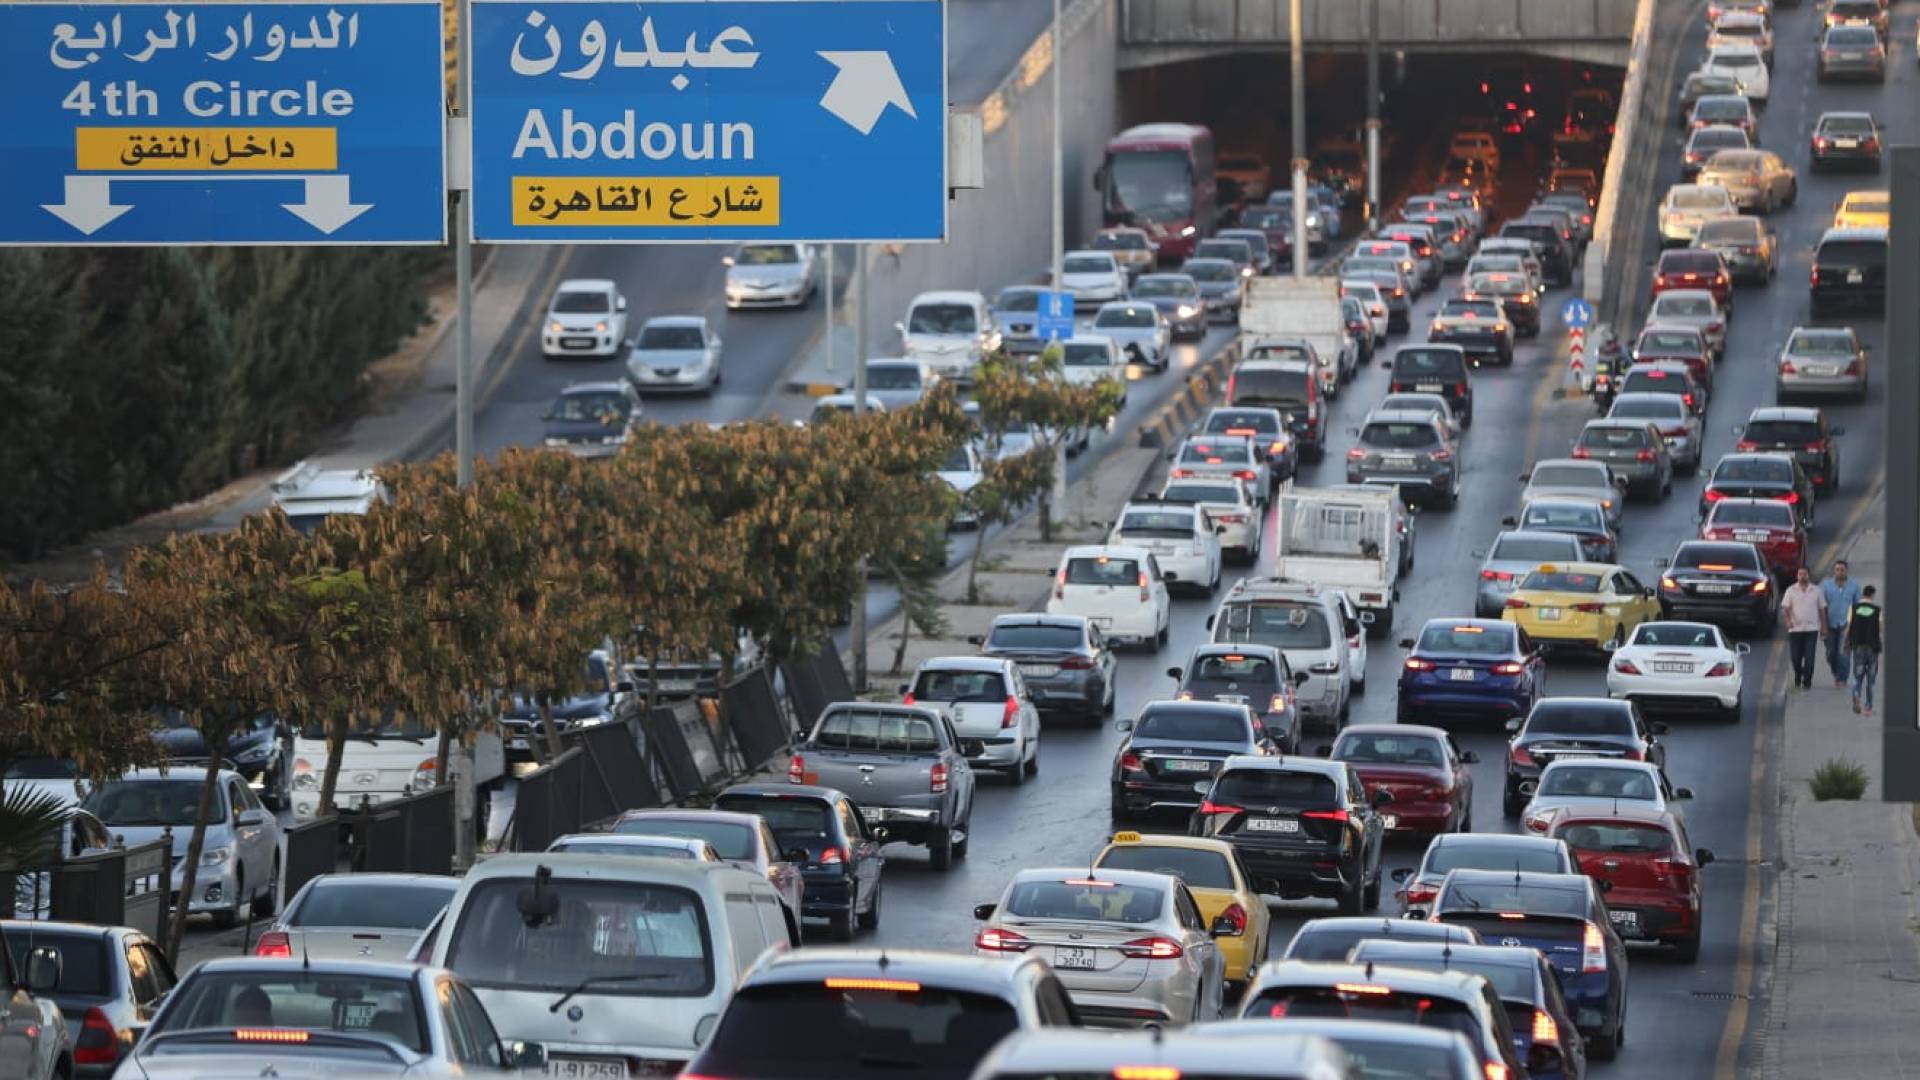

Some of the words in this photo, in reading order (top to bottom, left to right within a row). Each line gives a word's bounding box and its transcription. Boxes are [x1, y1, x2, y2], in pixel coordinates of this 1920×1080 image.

[50, 9, 196, 69] الرابع
[207, 9, 359, 62] الدوار
[509, 9, 760, 91] عبدون
[62, 80, 158, 116] 4th
[183, 80, 354, 116] Circle
[120, 135, 201, 166] النفق
[210, 134, 295, 166] داخل
[511, 108, 755, 160] Abdoun
[528, 185, 652, 221] القاهرة
[669, 185, 763, 220] شارع
